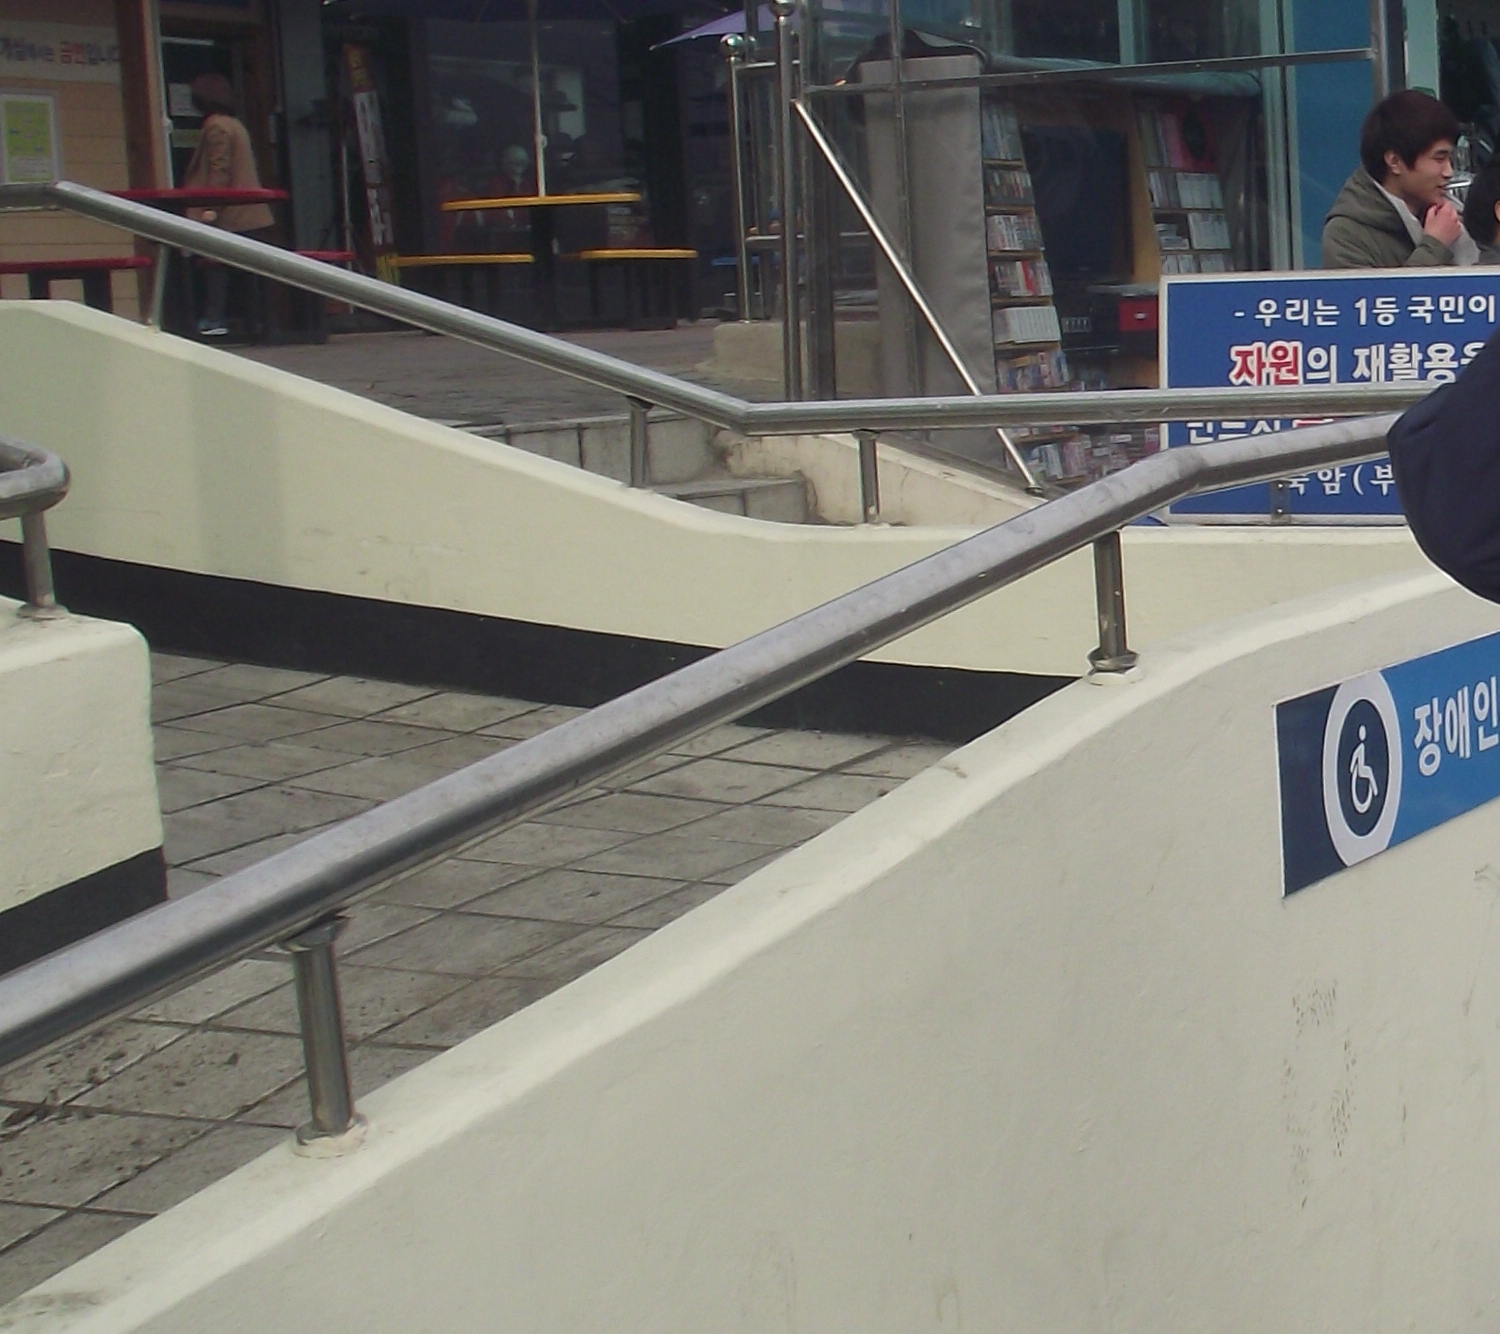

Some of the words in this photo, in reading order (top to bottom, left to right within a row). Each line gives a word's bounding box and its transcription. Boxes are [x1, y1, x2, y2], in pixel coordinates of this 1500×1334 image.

[1254, 297, 1341, 327] 우리는
[1406, 293, 1497, 325] 국민이
[1229, 339, 1338, 386] 자원의
